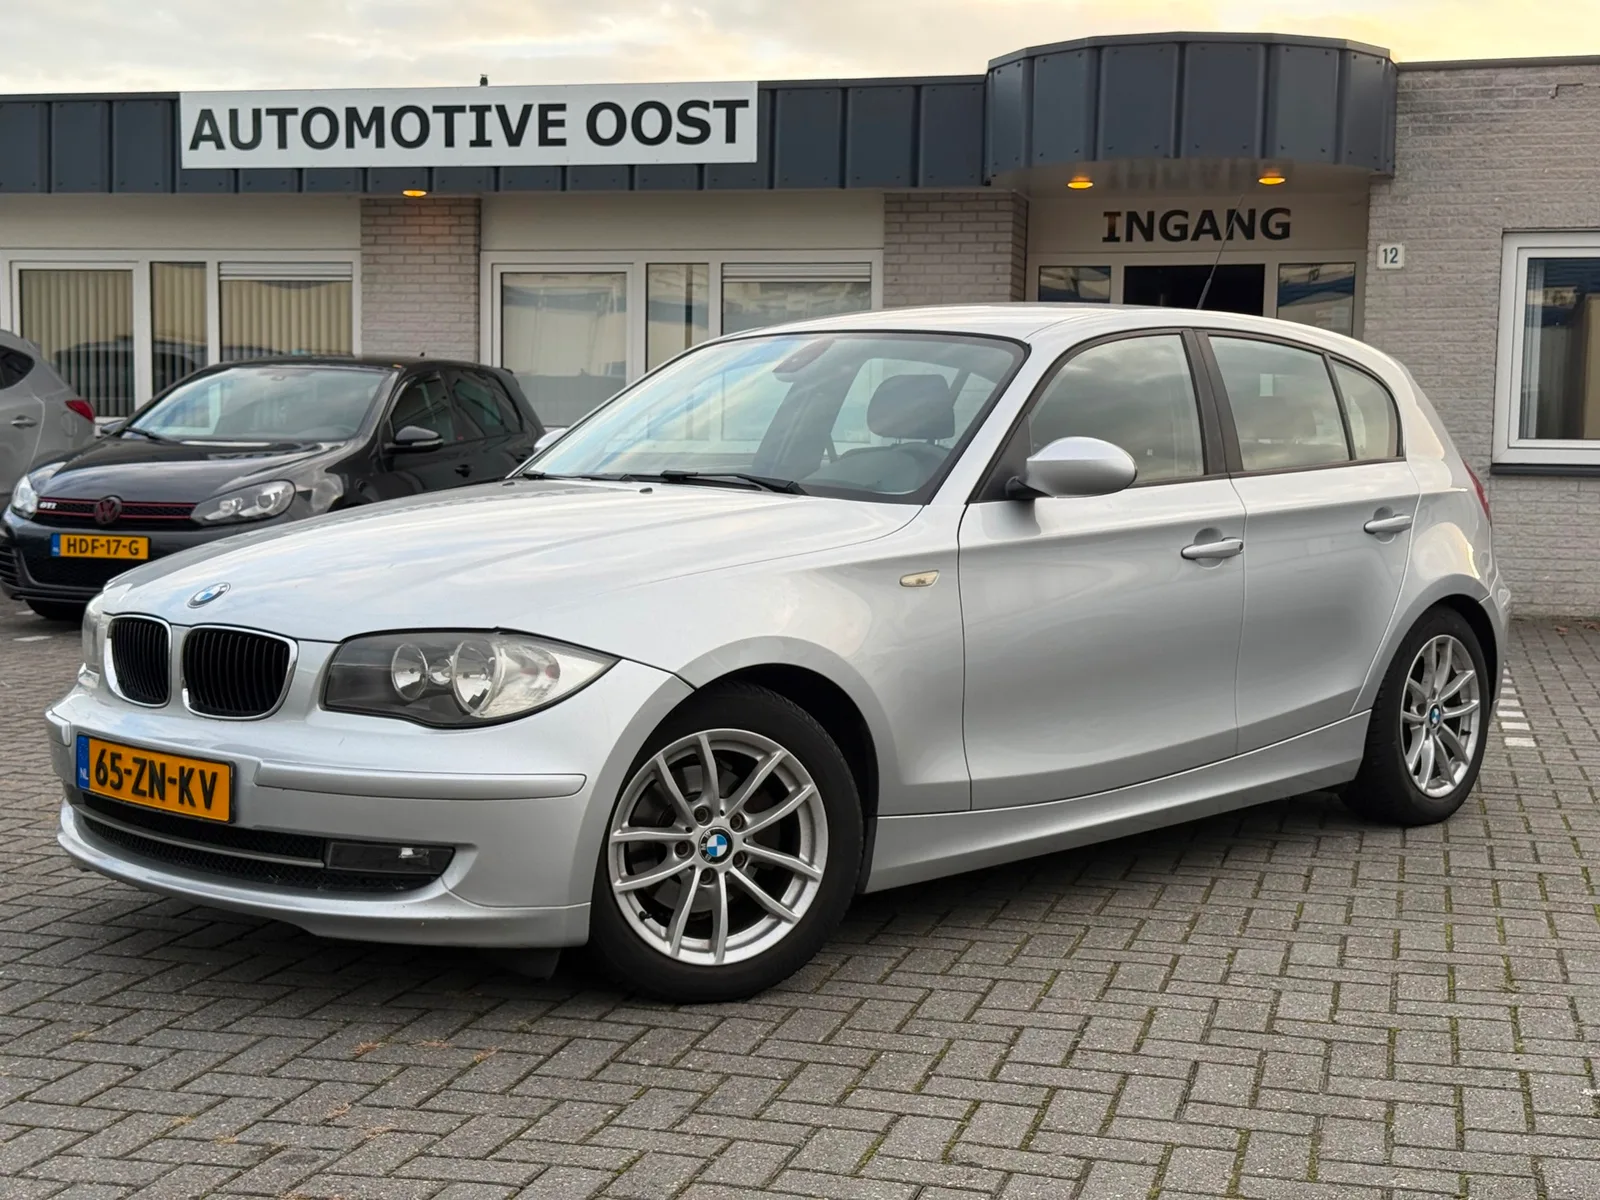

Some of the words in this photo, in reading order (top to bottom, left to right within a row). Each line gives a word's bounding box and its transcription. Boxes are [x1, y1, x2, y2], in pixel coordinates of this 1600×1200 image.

[189, 103, 567, 151] AUTOMOTIVE
[585, 99, 750, 147] OOST
[1102, 207, 1291, 242] INGANG
[1383, 247, 1399, 265] 12
[66, 538, 140, 555] HDF-17-G
[79, 767, 89, 780] NL
[95, 748, 218, 810] 65-ZN-KV
